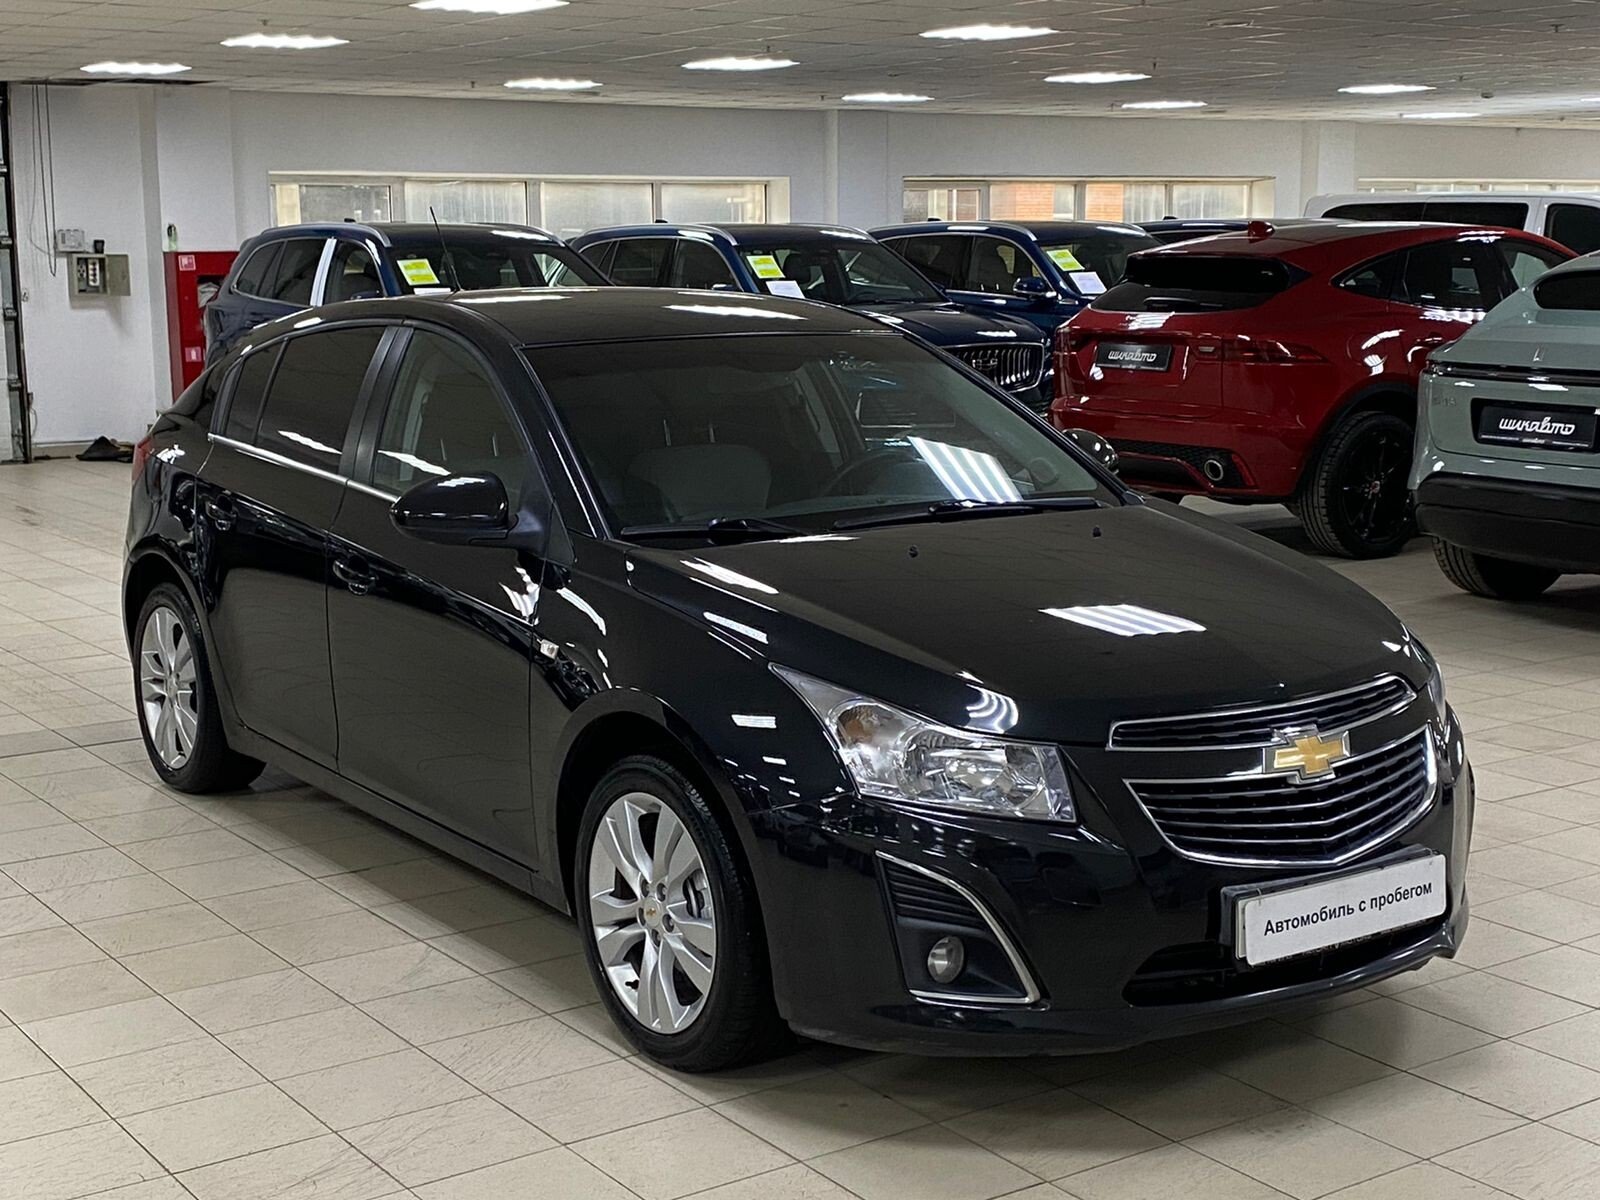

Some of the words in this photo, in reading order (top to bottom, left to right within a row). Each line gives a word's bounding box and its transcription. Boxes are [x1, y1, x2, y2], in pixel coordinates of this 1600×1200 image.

[1264, 906, 1355, 936] Автомобиль
[1358, 899, 1367, 912] с
[1370, 882, 1432, 911] пробегом
